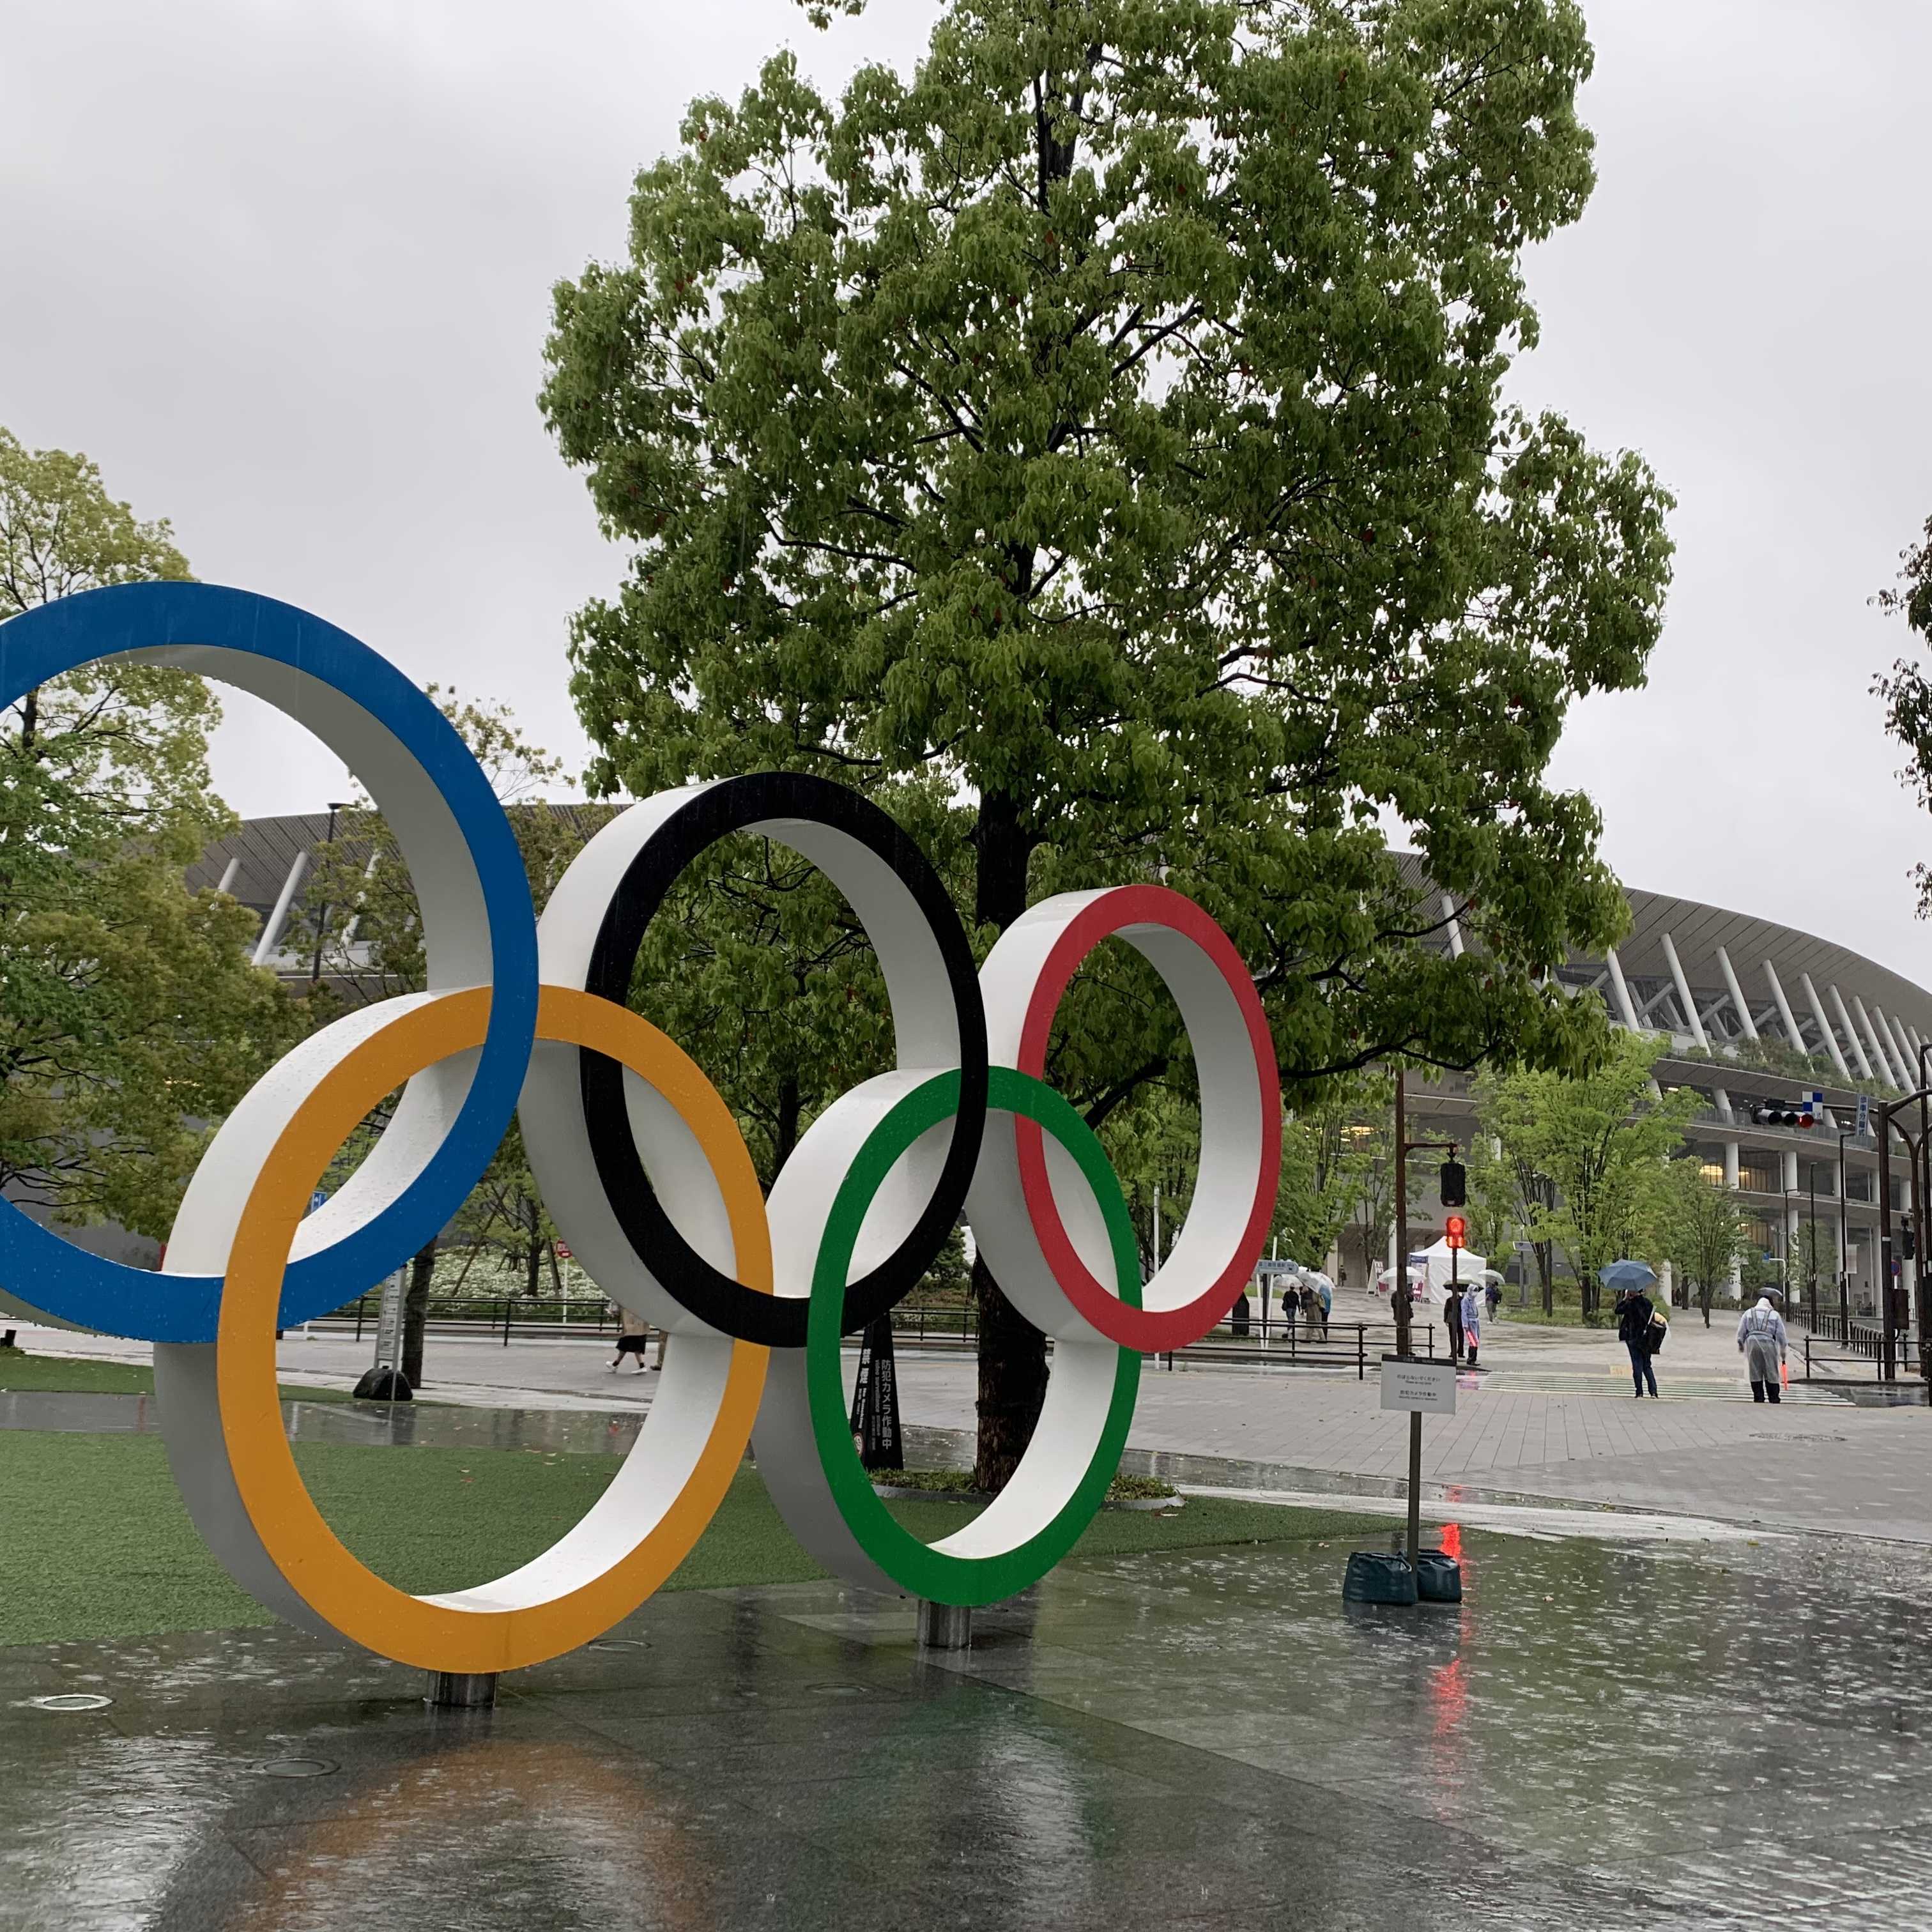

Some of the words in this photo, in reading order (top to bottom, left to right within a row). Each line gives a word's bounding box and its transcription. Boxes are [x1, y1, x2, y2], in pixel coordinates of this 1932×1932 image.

[859, 1348, 871, 1384] 禁煙
[881, 1359, 892, 1450] 防犯カメラ作動中
